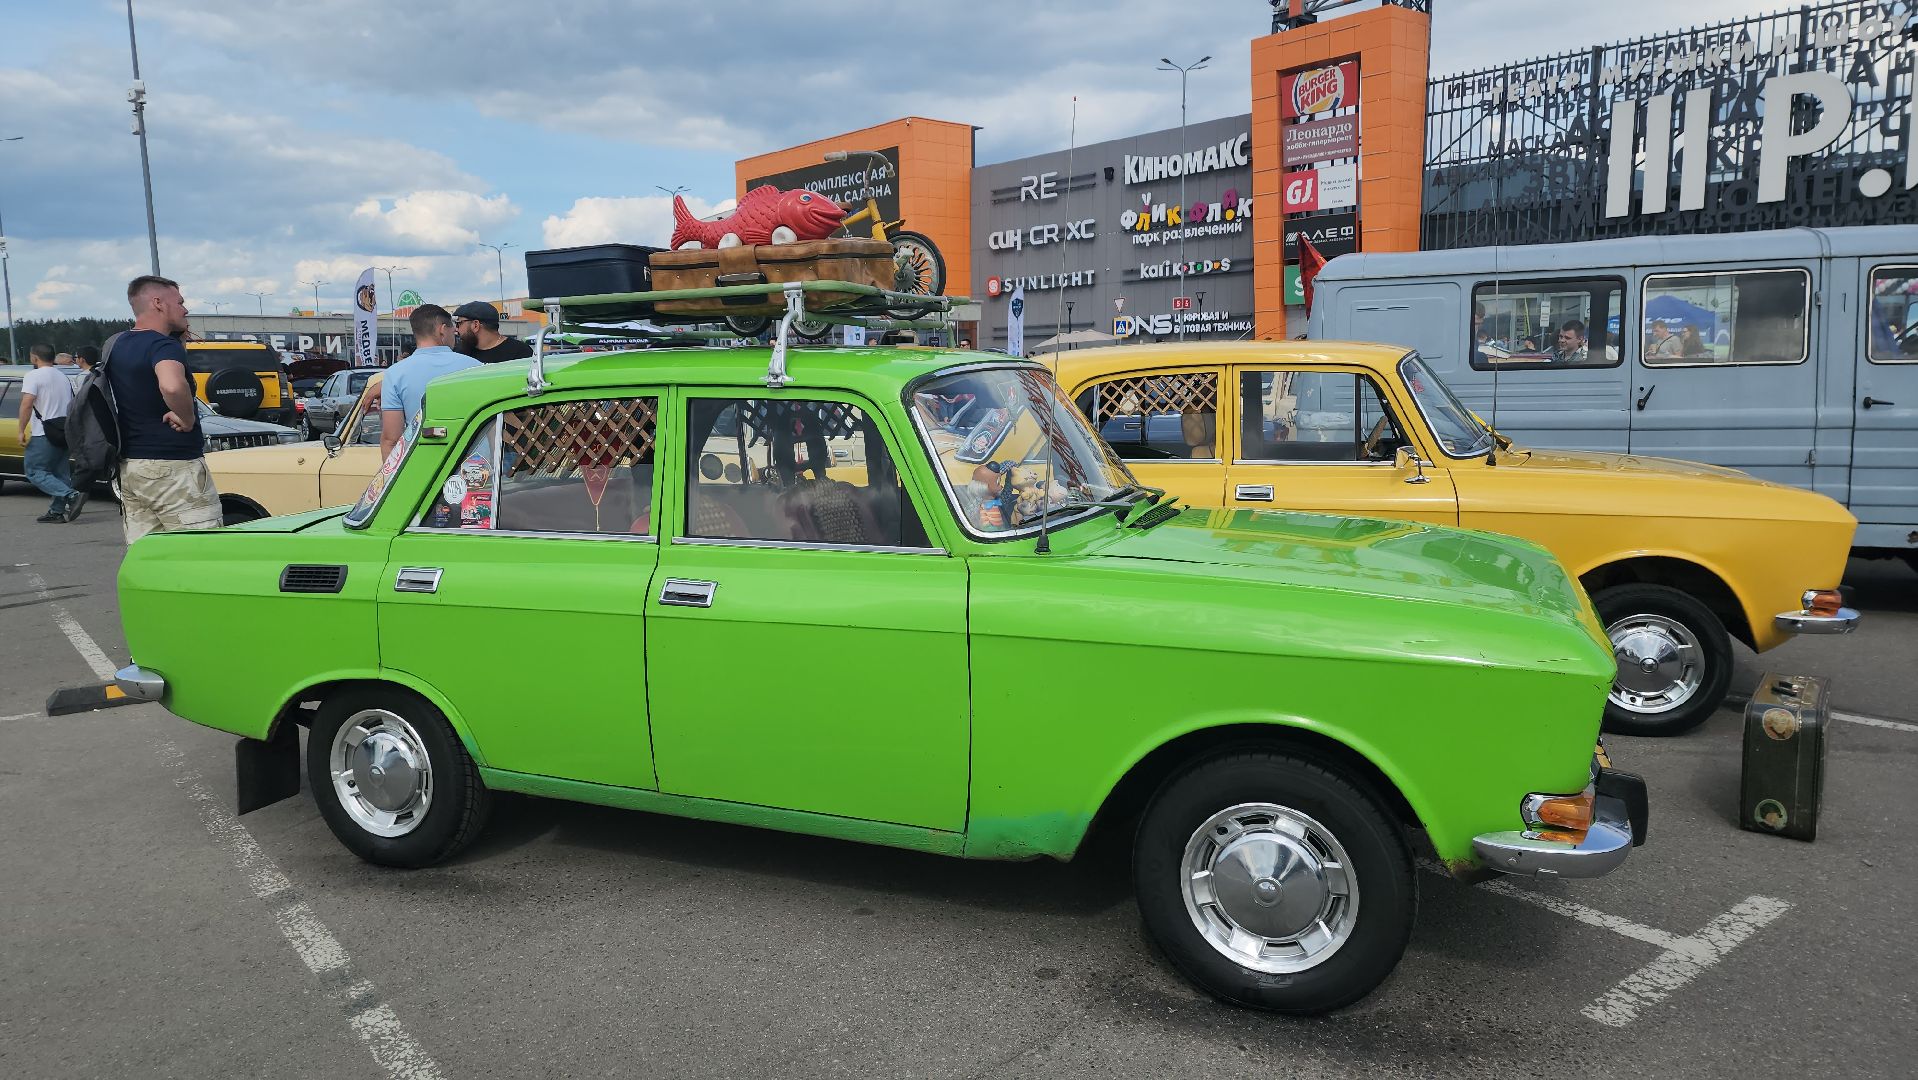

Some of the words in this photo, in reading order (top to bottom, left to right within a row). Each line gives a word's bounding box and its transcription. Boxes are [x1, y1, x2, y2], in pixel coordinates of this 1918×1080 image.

[1491, 70, 1581, 106] ТЕАТР
[1598, 41, 1755, 86] МУЗЫКИ
[1772, 33, 1797, 57] И
[1814, 9, 1913, 49] ШОУ
[1299, 69, 1336, 97] BURGER
[1300, 79, 1338, 112] KING
[1287, 123, 1353, 142] Леонардо
[1124, 132, 1248, 184] КИНОМАКС
[1004, 269, 1095, 292] SUNLIGHT
